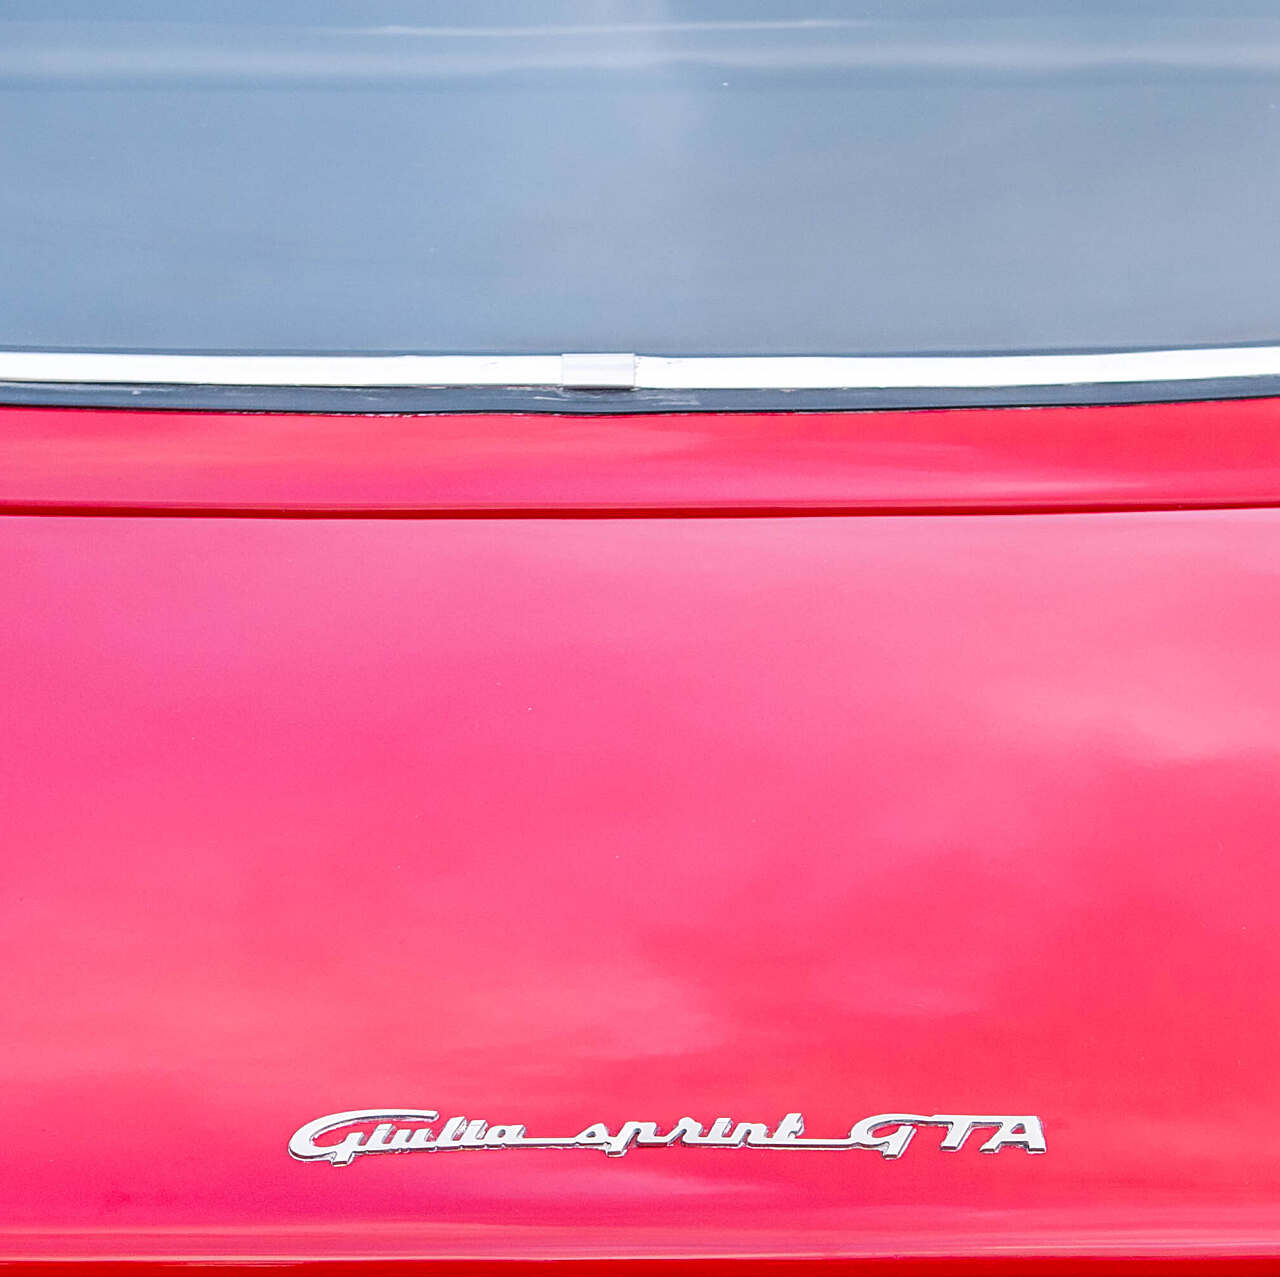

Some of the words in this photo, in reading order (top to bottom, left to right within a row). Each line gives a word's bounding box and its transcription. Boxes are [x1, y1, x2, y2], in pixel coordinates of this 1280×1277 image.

[288, 1108, 528, 1167] Giulia
[573, 1112, 805, 1158] sprint
[850, 1113, 1047, 1160] GTA
